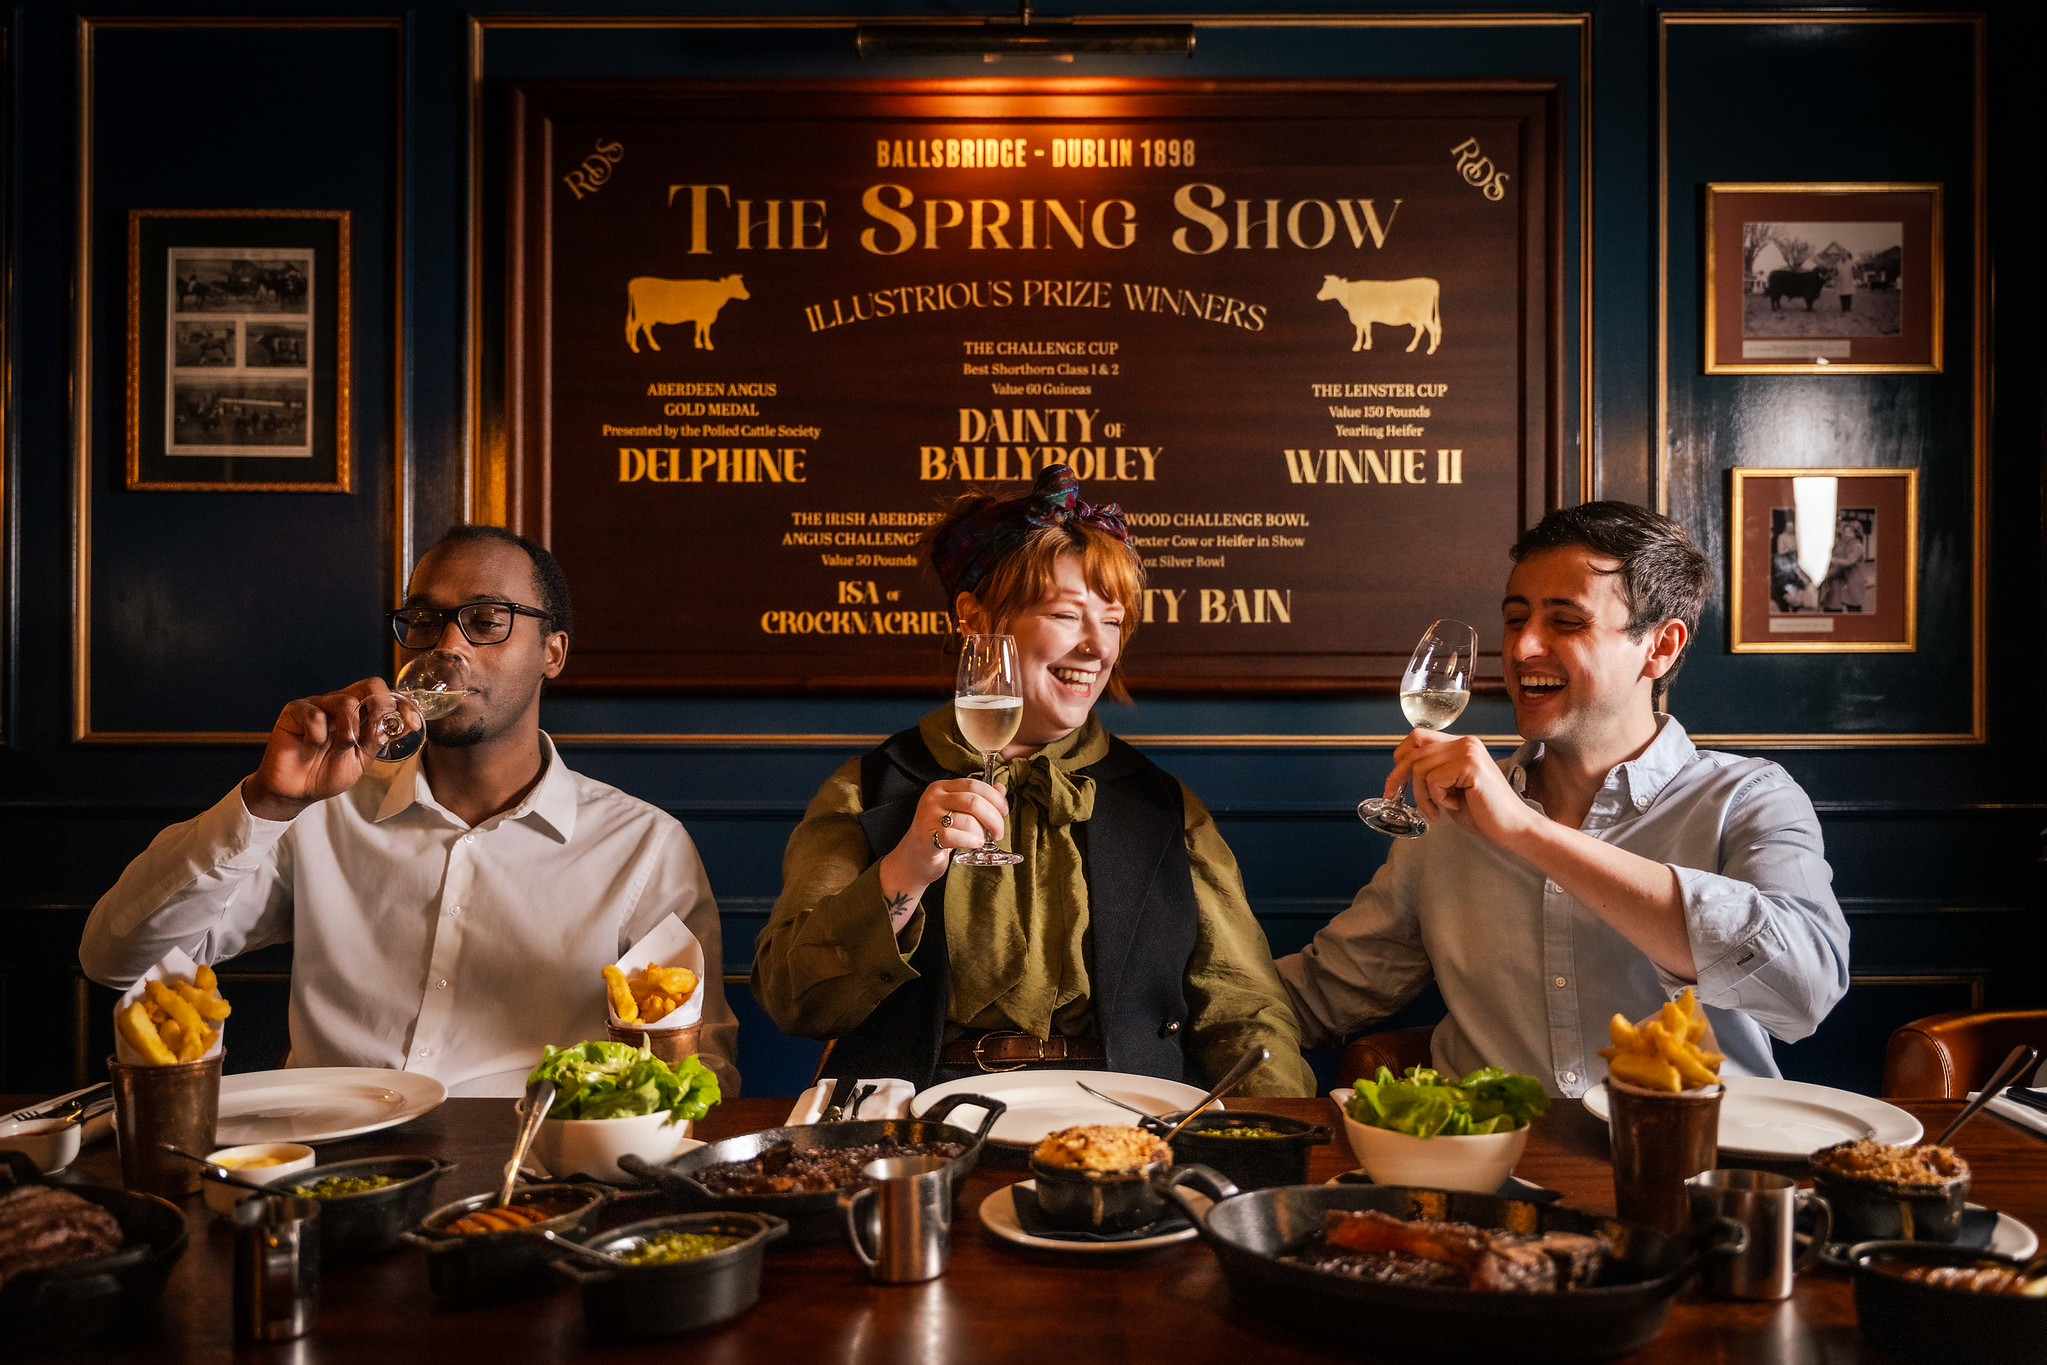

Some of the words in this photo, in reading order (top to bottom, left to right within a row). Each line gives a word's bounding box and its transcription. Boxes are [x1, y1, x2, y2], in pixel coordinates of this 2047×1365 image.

[877, 138, 1028, 168] BALLSBRIDGE
[1052, 138, 1133, 168] DUBLIN
[1140, 139, 1196, 168] 1898
[563, 137, 624, 200] RDS
[1449, 136, 1510, 201] RDS
[667, 184, 829, 255] THE
[860, 183, 1139, 256] SPRING
[1171, 182, 1404, 255] SHOW
[804, 280, 1014, 333] ILLUSTRIOUS
[1023, 280, 1112, 309] PRIZE
[1123, 283, 1268, 332] WINNERS
[963, 341, 994, 355] THE
[997, 341, 1086, 355] CHALLENGE
[1088, 341, 1119, 355] CUP
[963, 363, 988, 375] Best
[992, 362, 1055, 375] Shorthorn
[1057, 363, 1089, 375] Class
[1091, 363, 1097, 375] 1
[1099, 363, 1109, 375] &
[1111, 363, 1119, 375] 2
[647, 383, 725, 397] ABERDEEN
[727, 383, 777, 397] ANGUS
[991, 383, 1025, 396] Value
[1026, 383, 1041, 396] 60
[1043, 383, 1092, 396] Guineas
[1311, 383, 1342, 398] THE
[1345, 383, 1415, 398] LEINSTER
[1417, 383, 1448, 398] CUP
[664, 403, 705, 417] GOLD
[708, 403, 760, 417] MEDAL
[1328, 405, 1361, 419] Value
[1364, 405, 1384, 418] 150
[1386, 405, 1431, 419] Pounds
[602, 424, 662, 437] Presented
[664, 424, 678, 440] by
[680, 425, 700, 437] the
[741, 424, 776, 437] Cattle
[778, 424, 821, 440] Society
[959, 408, 1100, 443] DAINTY
[1103, 423, 1125, 438] OF
[1335, 424, 1384, 439] Yearling
[1386, 423, 1425, 437] Heifer
[618, 447, 807, 483] DELPHINE
[1284, 448, 1427, 484] WINNIE
[1437, 448, 1464, 484] II
[792, 512, 822, 526] THE
[825, 512, 866, 526] IRISH
[1173, 513, 1263, 527] CHALLENGE
[1265, 513, 1310, 527] BOWL
[782, 532, 833, 546] ANGUS
[1171, 535, 1198, 547] Cow
[1200, 537, 1213, 547] or
[1217, 535, 1256, 547] Heifer
[1257, 535, 1270, 547] in
[1272, 535, 1305, 547] Show
[821, 554, 853, 567] Value
[855, 554, 871, 566] 50
[873, 554, 918, 567] Pounds
[1143, 558, 1158, 568] oz
[1159, 556, 1195, 568] Silver
[1196, 556, 1225, 568] Bowl
[838, 581, 880, 605] ISA
[1200, 589, 1292, 624] BAIN
